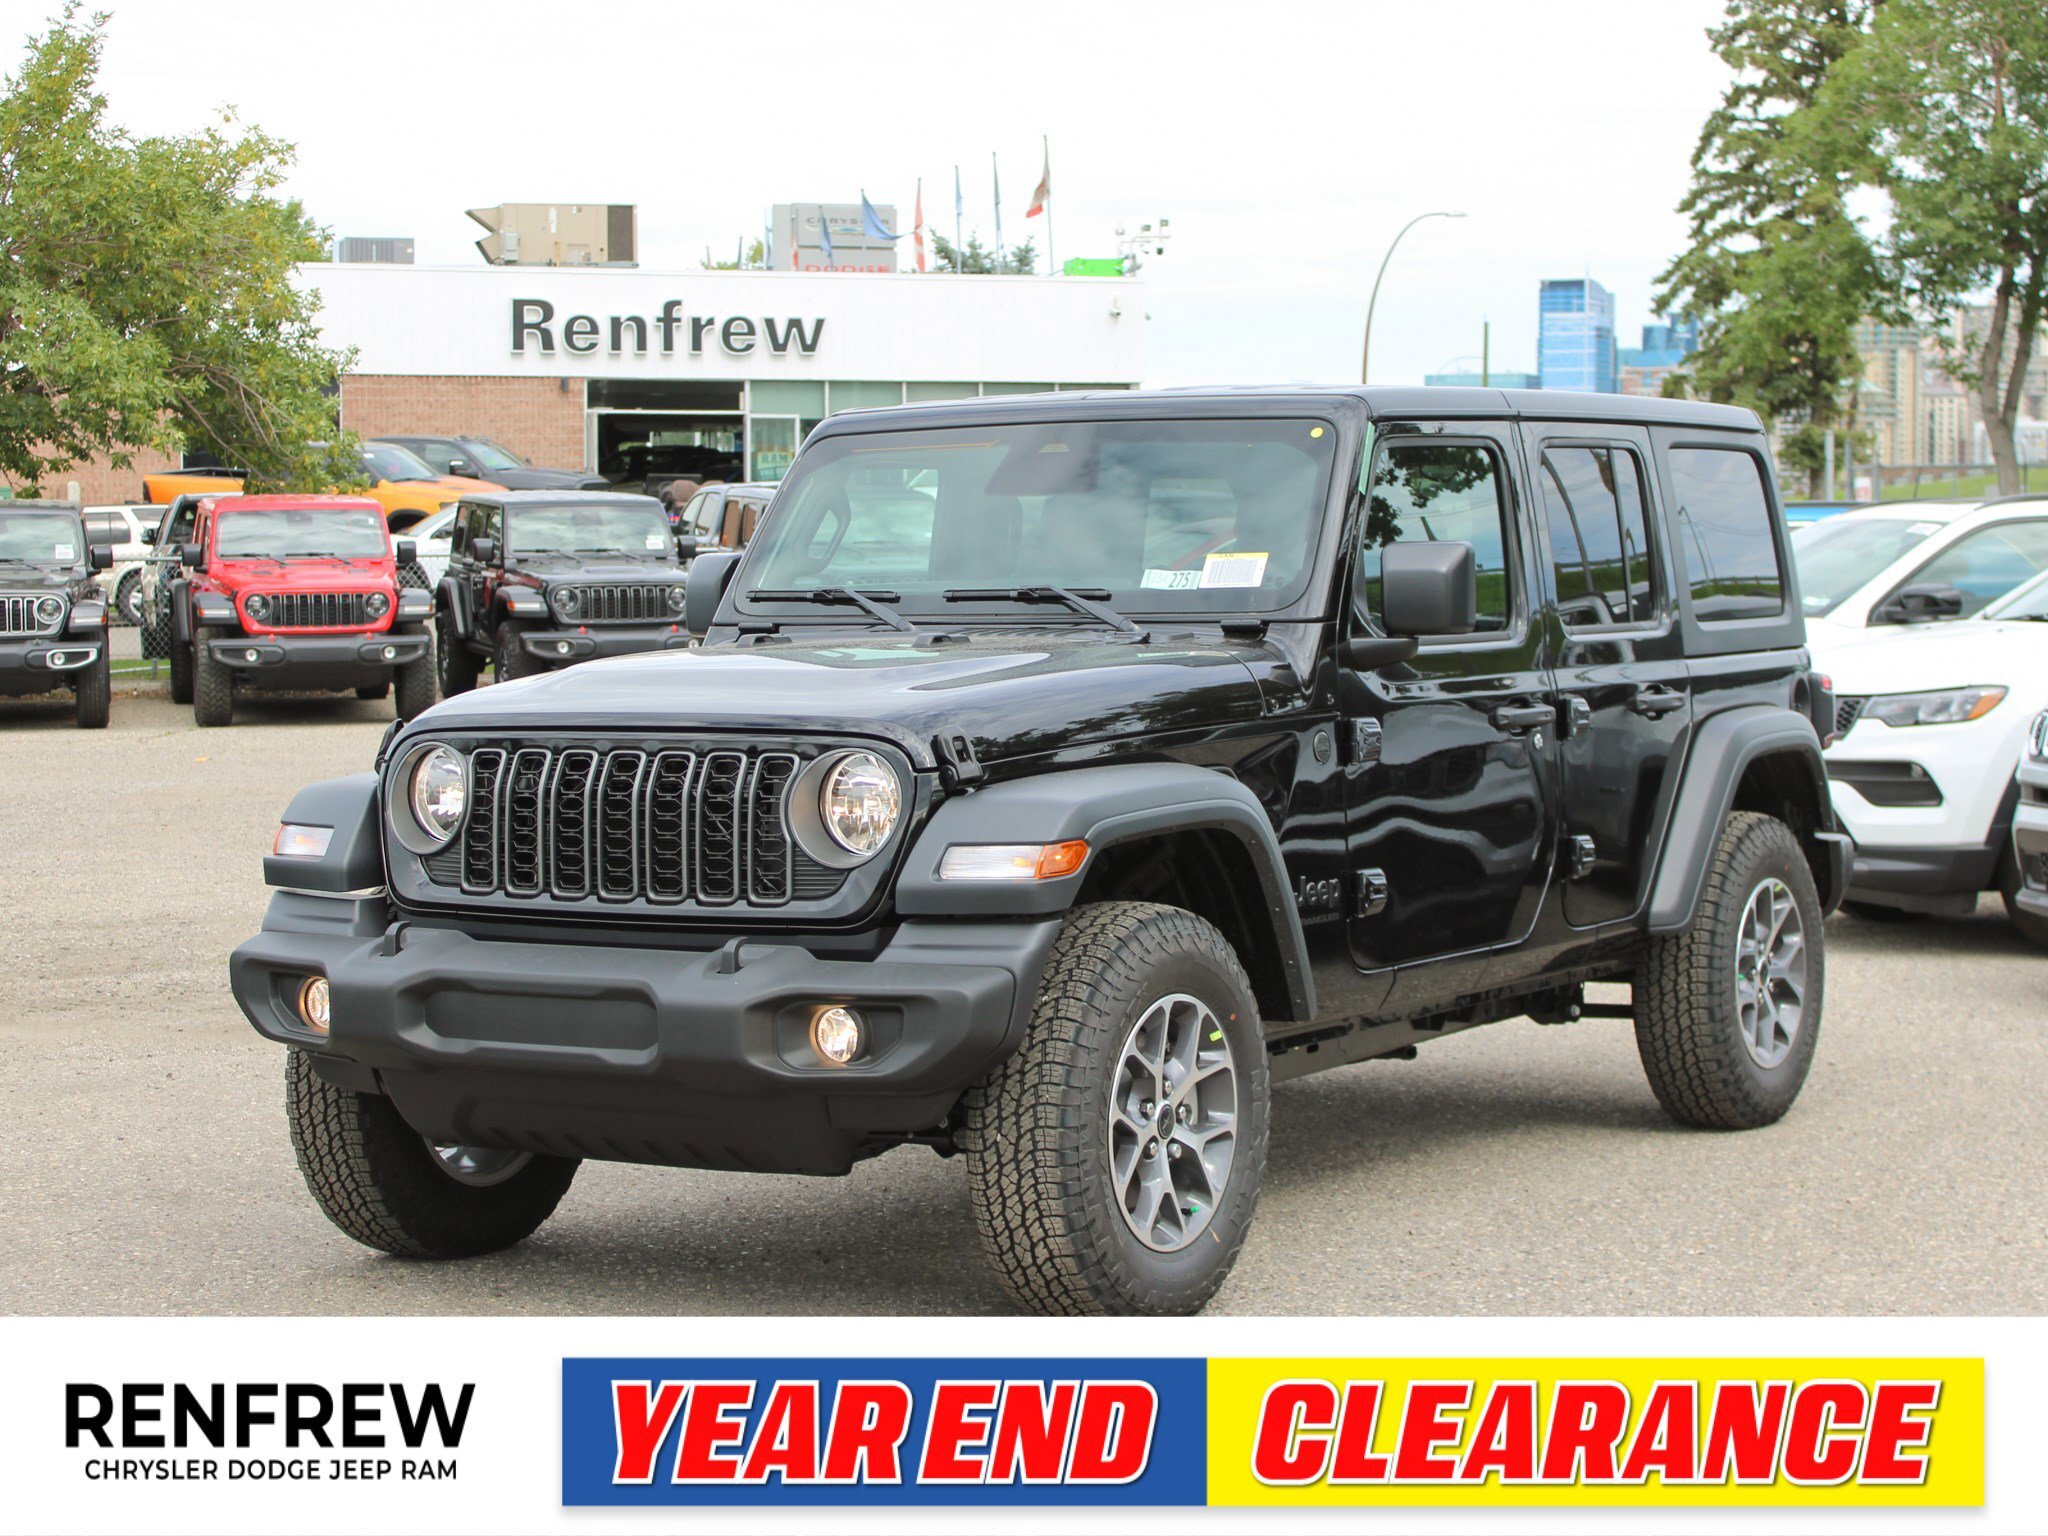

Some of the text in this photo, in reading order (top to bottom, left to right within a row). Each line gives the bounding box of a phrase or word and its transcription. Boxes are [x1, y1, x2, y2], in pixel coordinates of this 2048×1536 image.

[806, 217, 889, 225] CRYSR
[511, 298, 825, 355] Renfrew
[1293, 875, 1340, 908] Jeep
[1301, 912, 1340, 926] RANGLER
